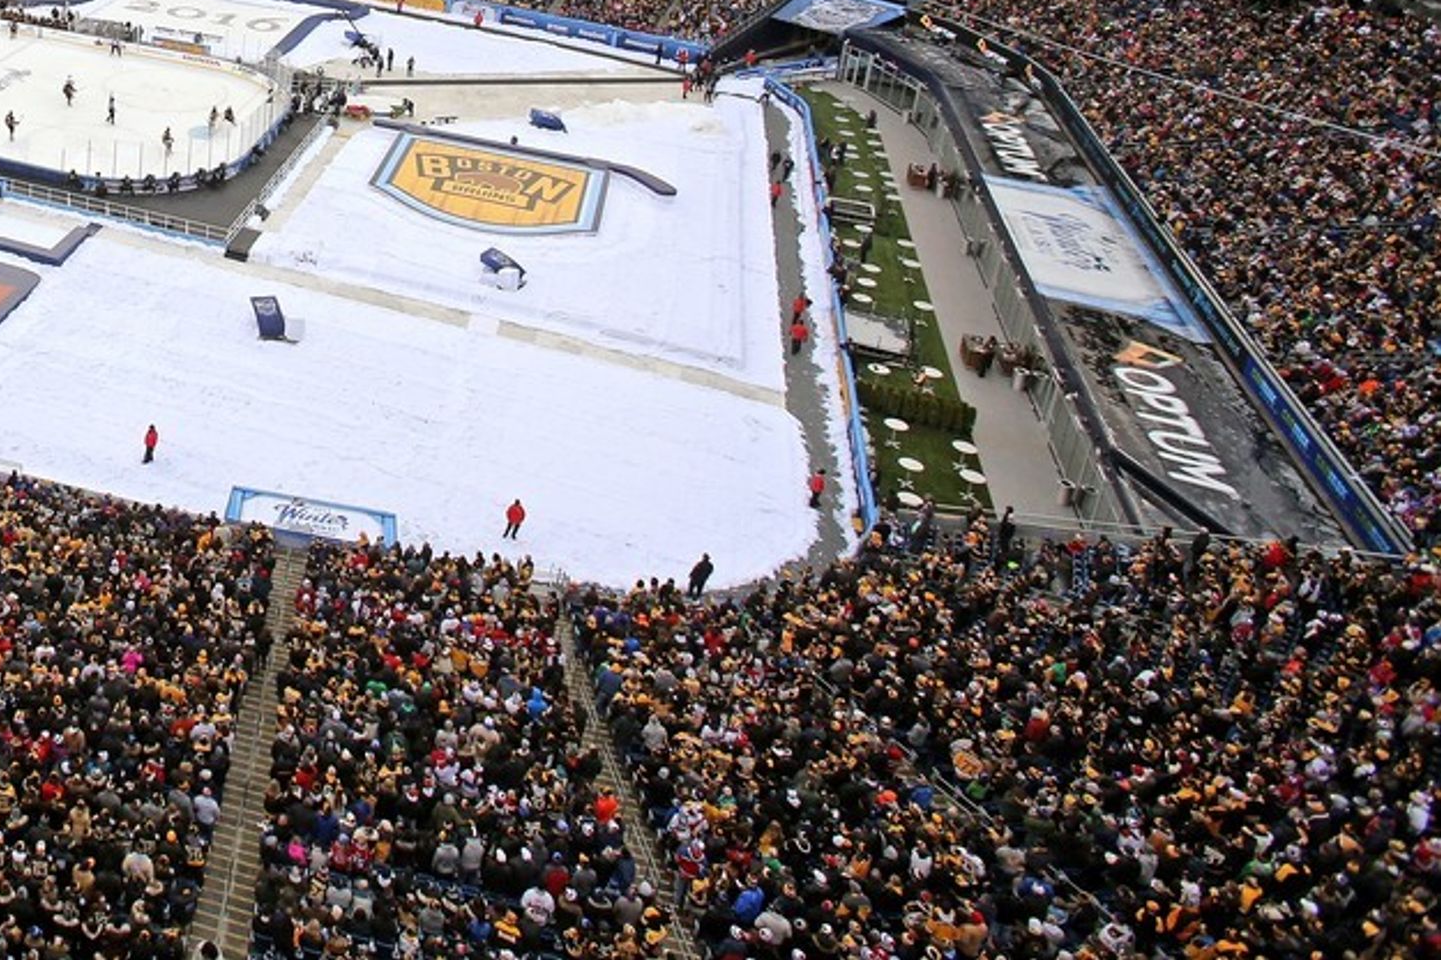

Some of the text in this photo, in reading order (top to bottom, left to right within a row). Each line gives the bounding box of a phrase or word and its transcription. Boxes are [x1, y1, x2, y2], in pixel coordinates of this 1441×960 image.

[124, 0, 289, 32] 2016
[981, 123, 1048, 182] OPTUM
[418, 154, 574, 204] BOSTON
[1114, 366, 1241, 501] OPTUM
[274, 502, 348, 530] Winter
